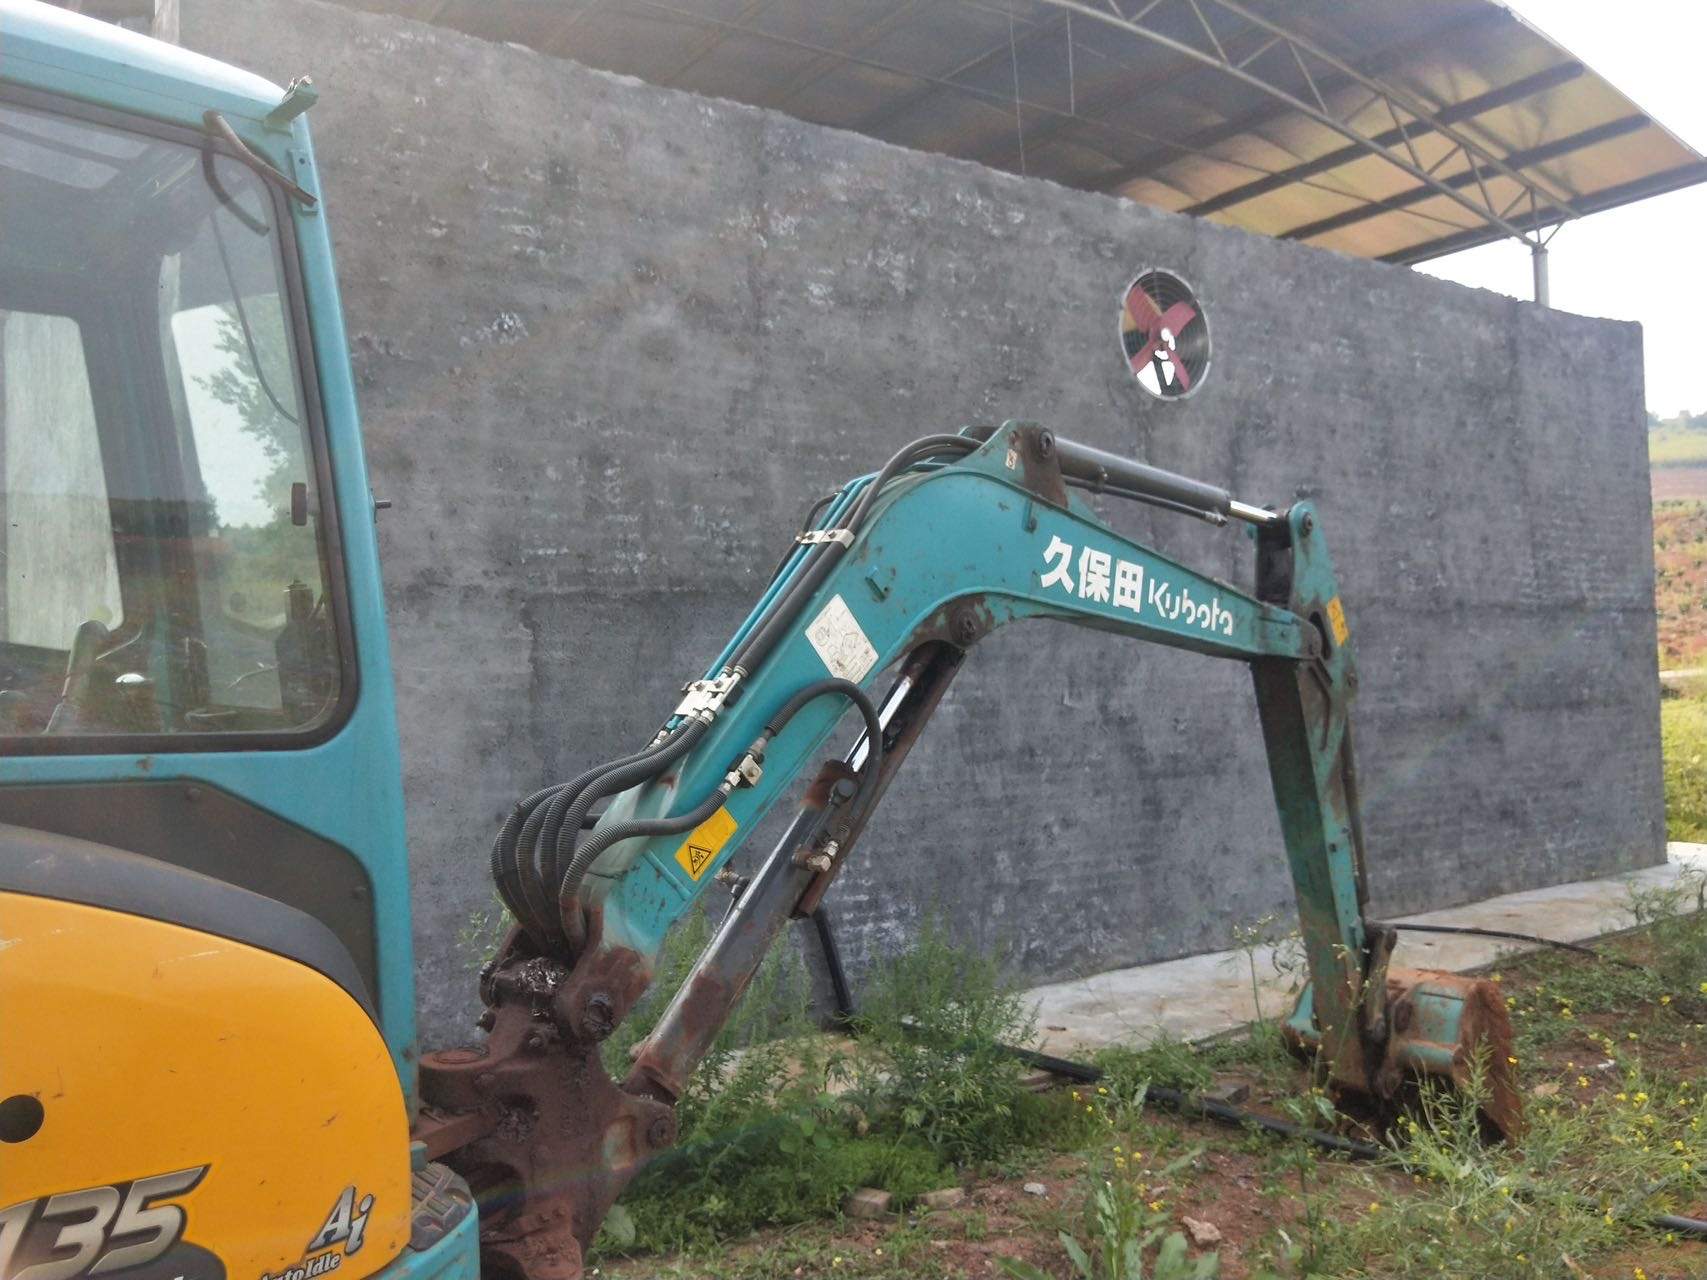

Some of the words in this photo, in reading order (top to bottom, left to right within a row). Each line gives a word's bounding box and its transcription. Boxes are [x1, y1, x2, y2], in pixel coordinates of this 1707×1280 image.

[1041, 535, 1144, 613] 久保田
[1148, 578, 1233, 636] Kubota
[308, 1185, 374, 1256] Ai
